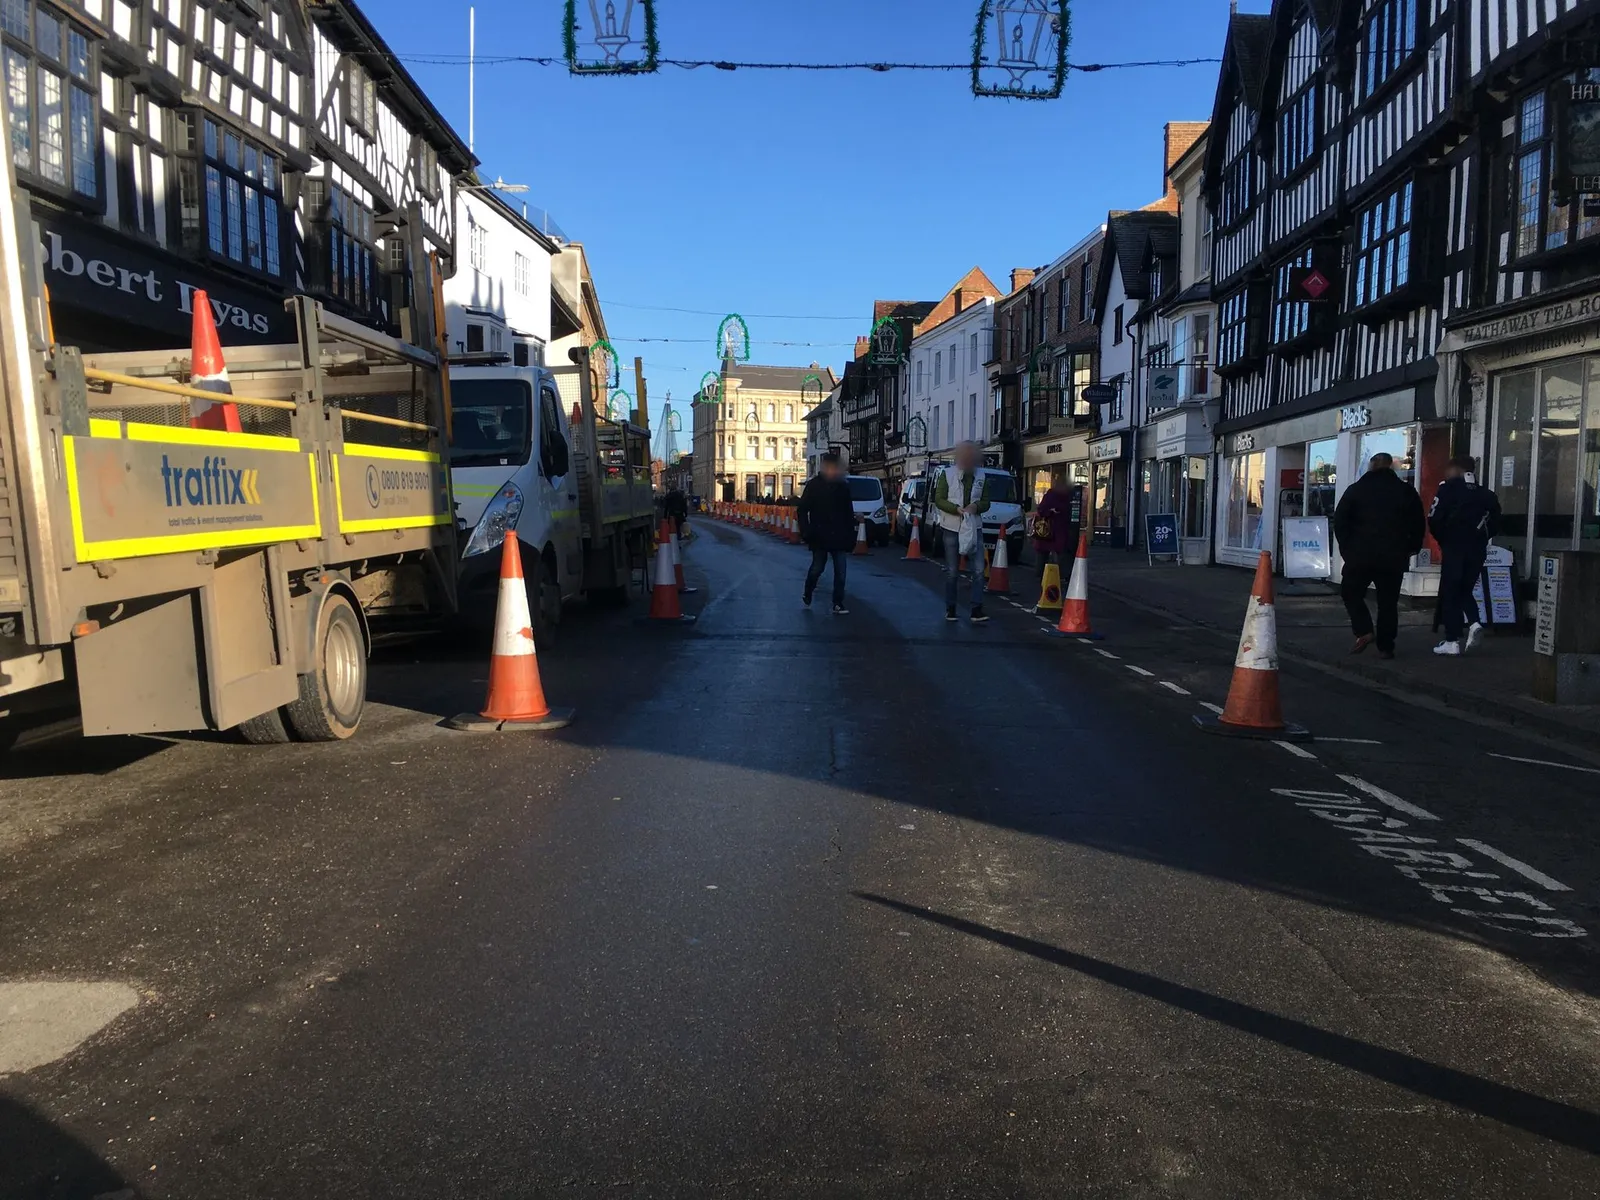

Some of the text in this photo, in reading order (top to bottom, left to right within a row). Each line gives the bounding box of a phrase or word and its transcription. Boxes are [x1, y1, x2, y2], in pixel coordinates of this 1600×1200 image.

[1464, 311, 1539, 343] HATHAWAY
[1544, 303, 1573, 325] TEA
[1342, 405, 1368, 430] Blacks
[161, 454, 246, 507] traffix
[381, 470, 430, 491] 0800 819 9001
[1293, 540, 1320, 548] FINAL
